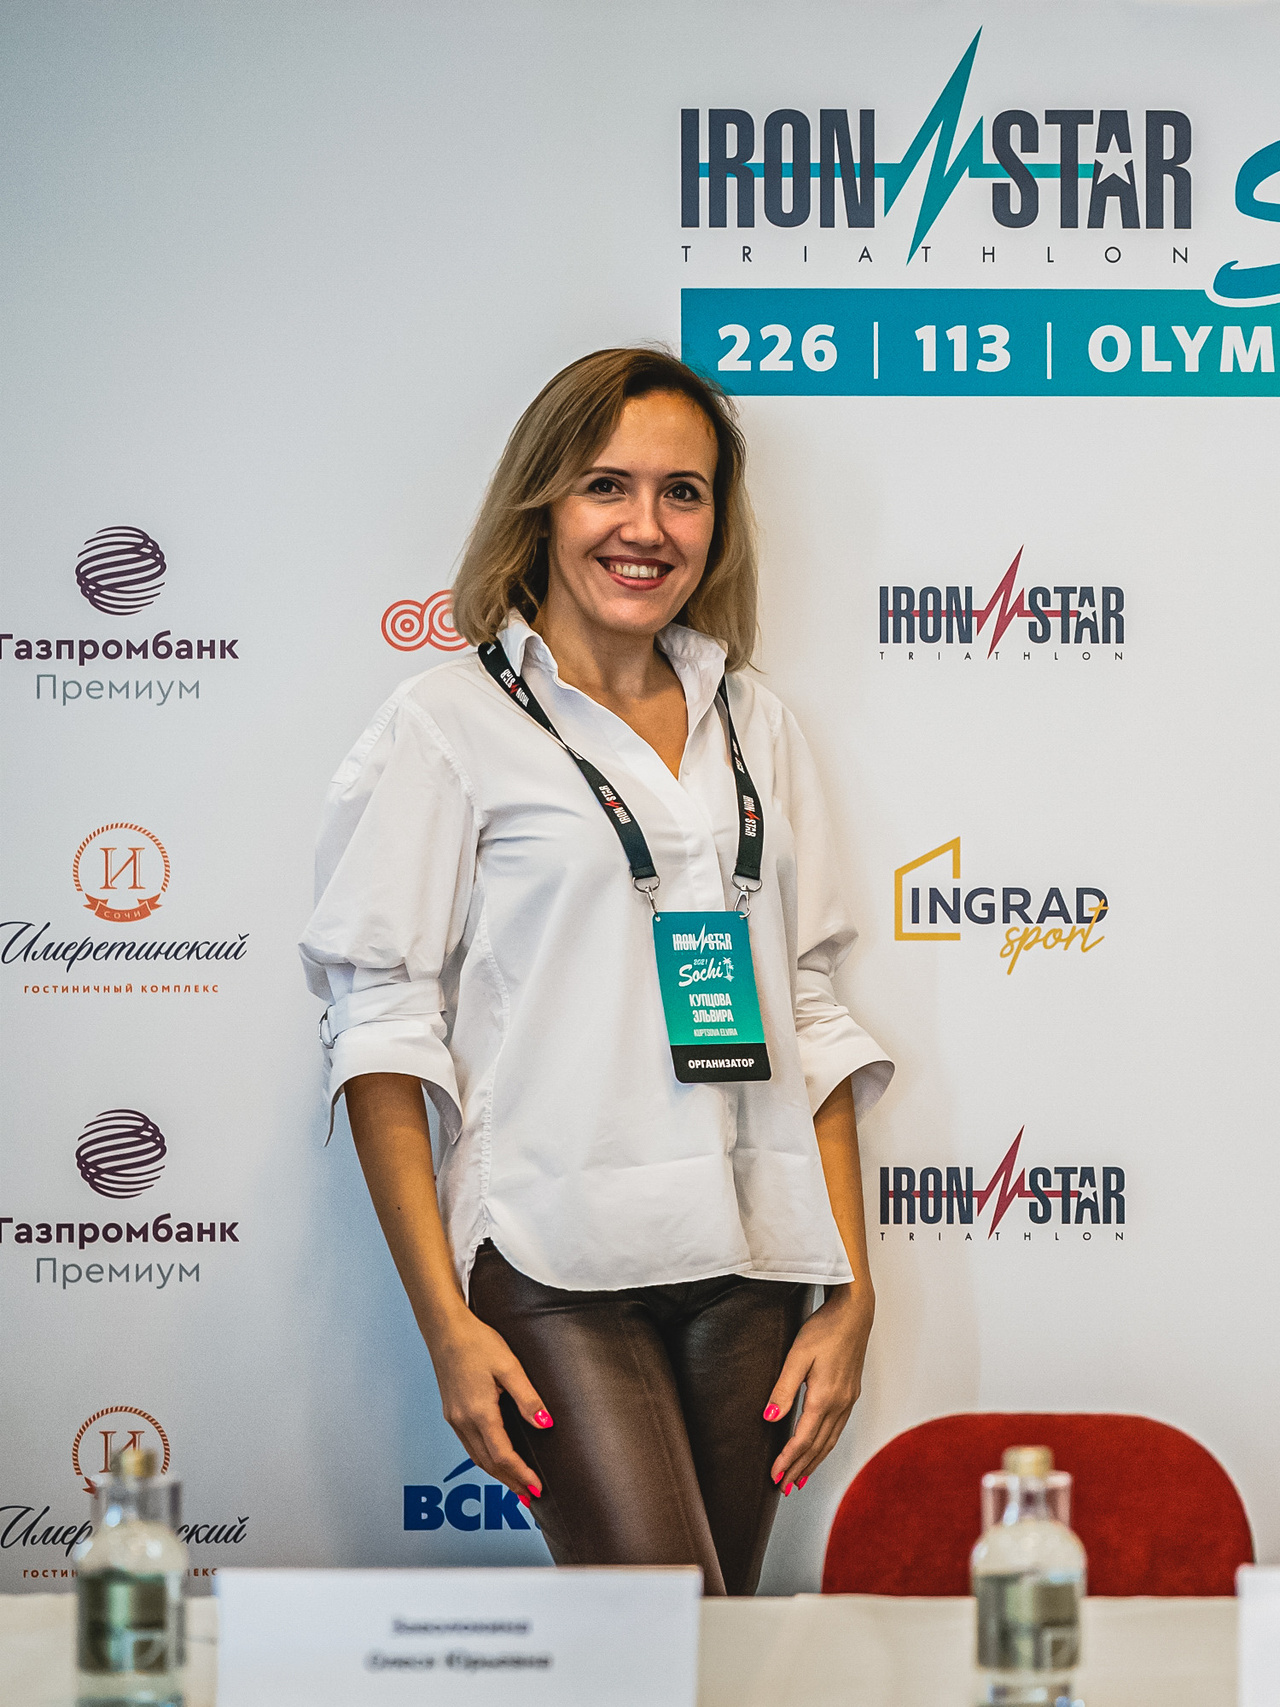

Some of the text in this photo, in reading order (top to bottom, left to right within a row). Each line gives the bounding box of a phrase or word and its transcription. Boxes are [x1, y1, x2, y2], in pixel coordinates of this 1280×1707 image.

[681, 245, 1189, 263] TRIATHLON
[717, 323, 838, 373] 226
[915, 324, 1011, 373] 113
[0, 629, 239, 666] Газпромбанк
[880, 651, 1123, 661] TRIATHLON
[36, 673, 200, 706] Премиум
[103, 910, 142, 920] СОЧИ
[911, 887, 1109, 925] INGRAD
[0, 921, 250, 973] Имеретинский
[999, 898, 1110, 975] sport
[678, 957, 723, 987] Sochi
[24, 983, 220, 994] ГОСТИНИЧНЫЙ КОМПЛЕКС
[689, 993, 732, 1008] КУПЦОВА
[692, 1009, 735, 1023] ЭЛЬВИРА
[687, 1058, 755, 1070] ОРГАНИЗАТОР
[0, 1212, 240, 1250] Газпромбанк
[880, 1232, 1124, 1241] TRIATHLON
[36, 1257, 200, 1290] Премиум
[0, 1505, 249, 1557] Имерский
